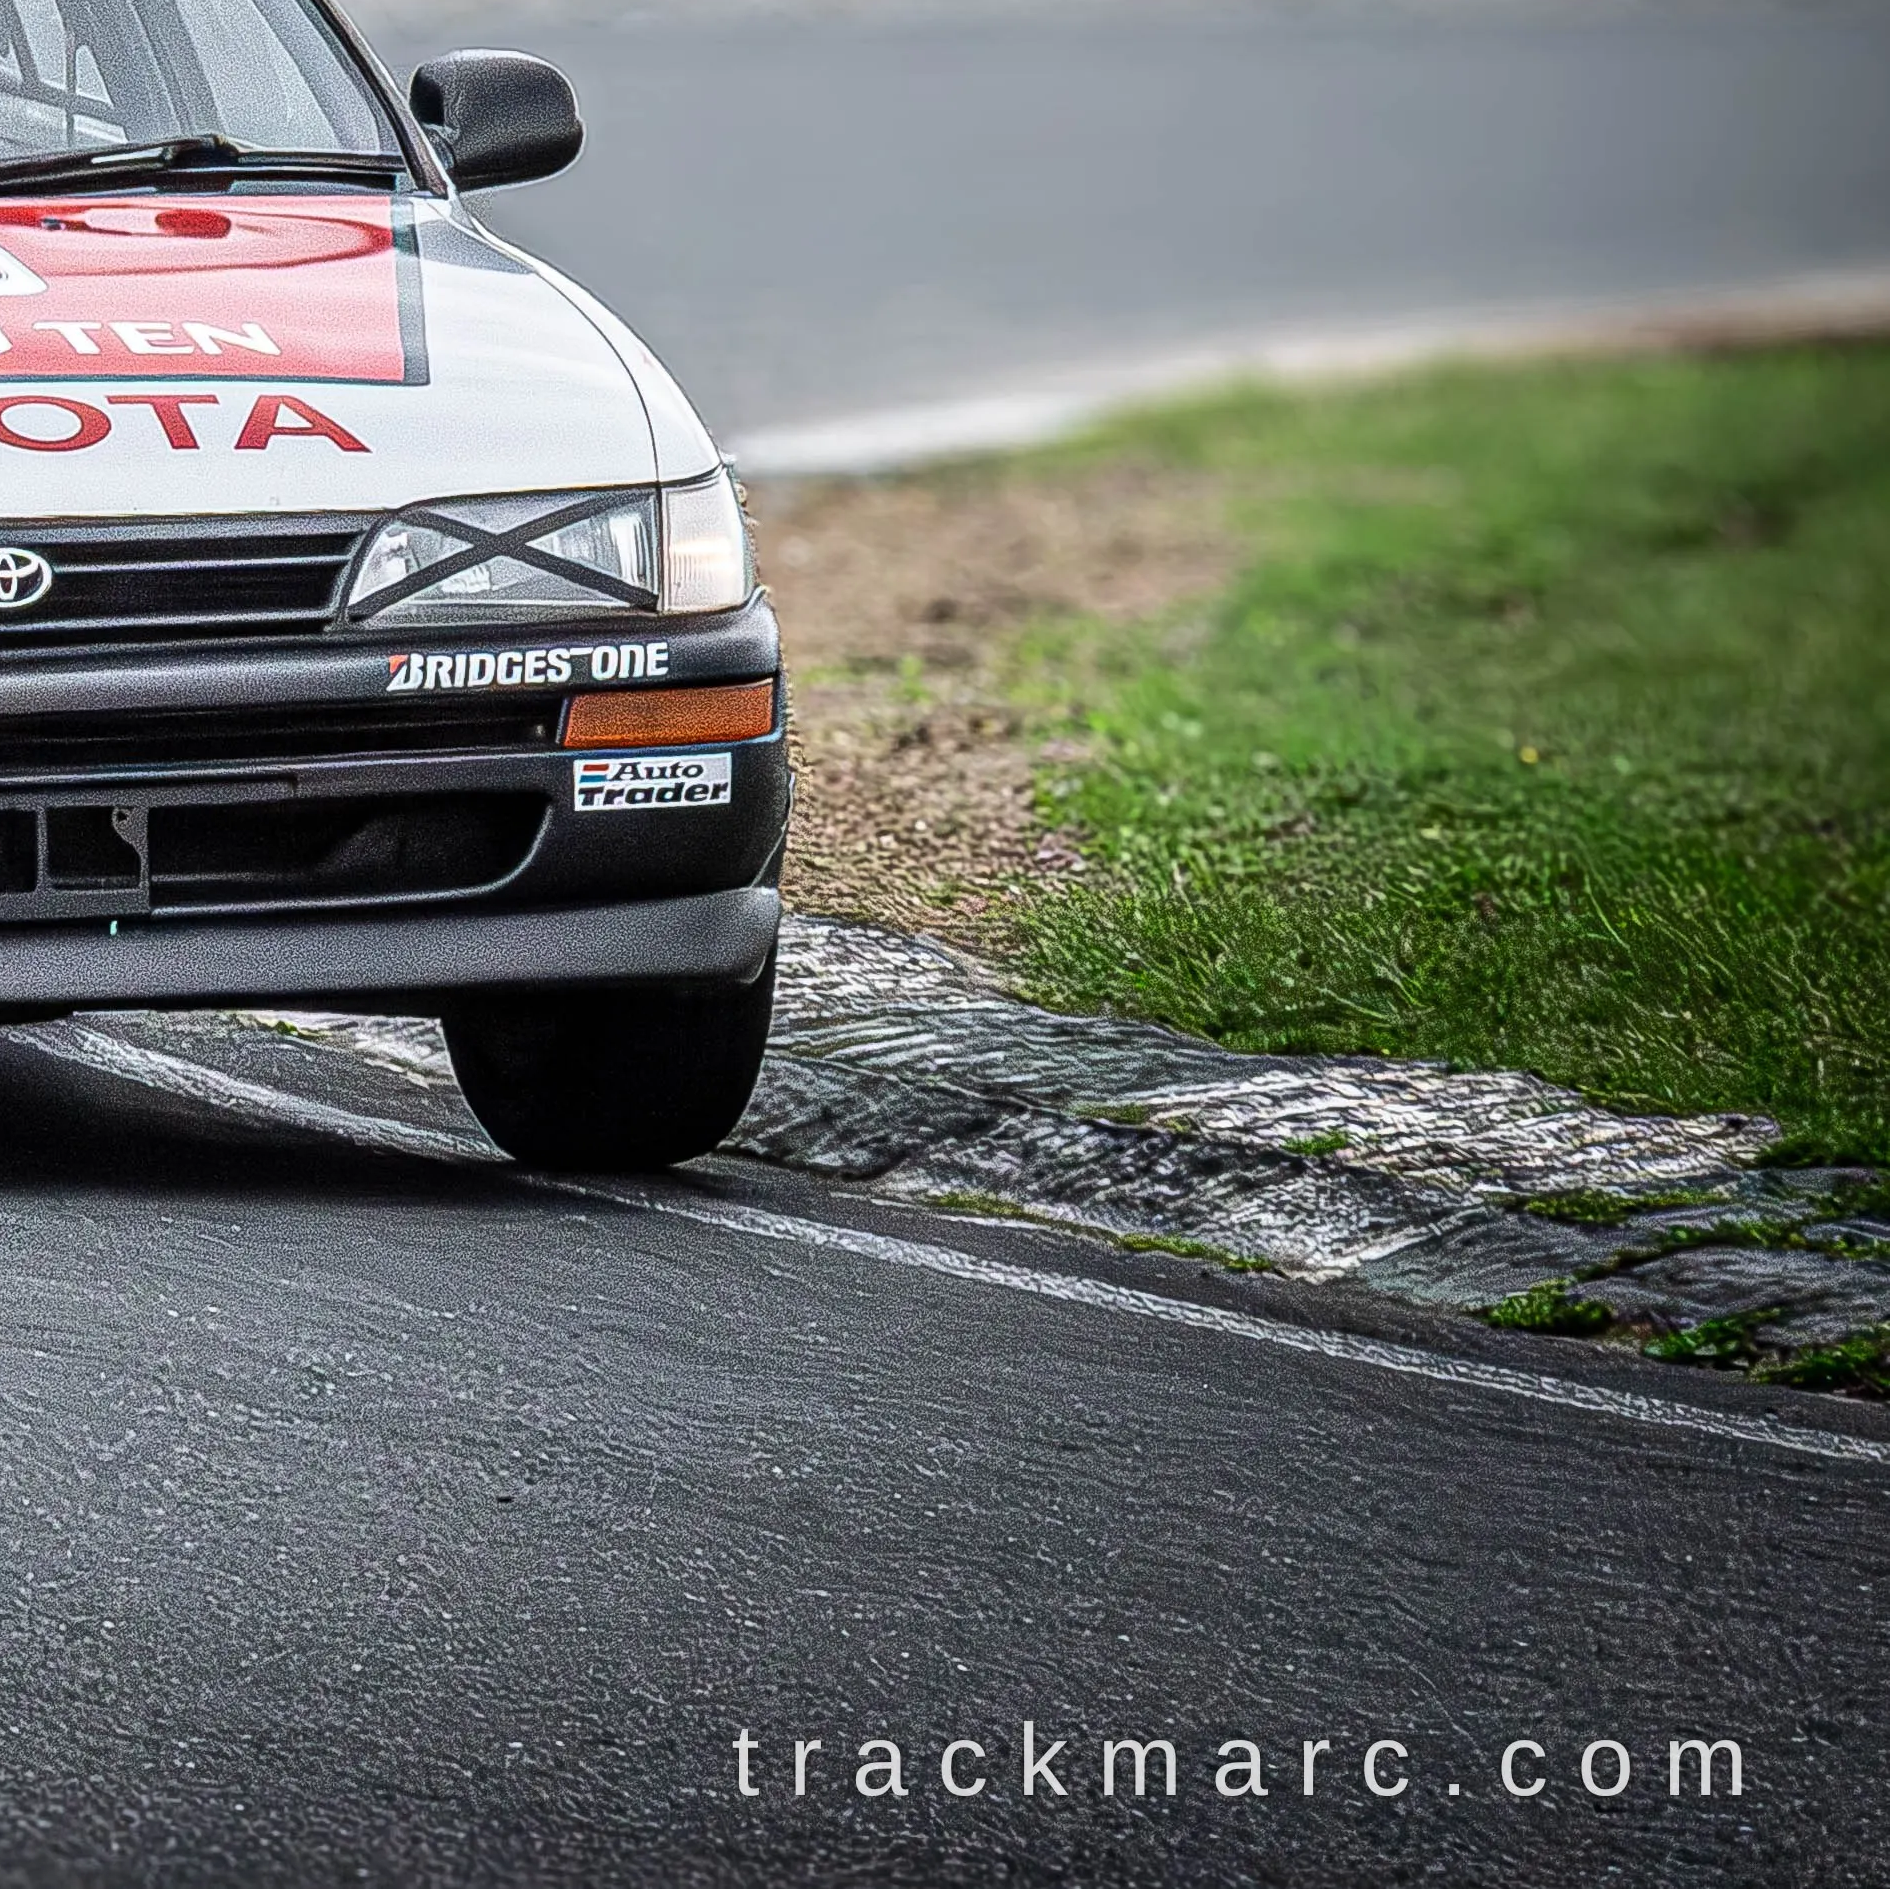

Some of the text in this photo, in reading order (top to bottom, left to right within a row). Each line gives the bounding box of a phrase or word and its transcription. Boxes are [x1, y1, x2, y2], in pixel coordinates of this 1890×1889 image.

[29, 321, 282, 356] TEN
[386, 642, 668, 691] BRIDGESONE
[609, 761, 704, 781] Auto
[578, 782, 729, 806] Trader
